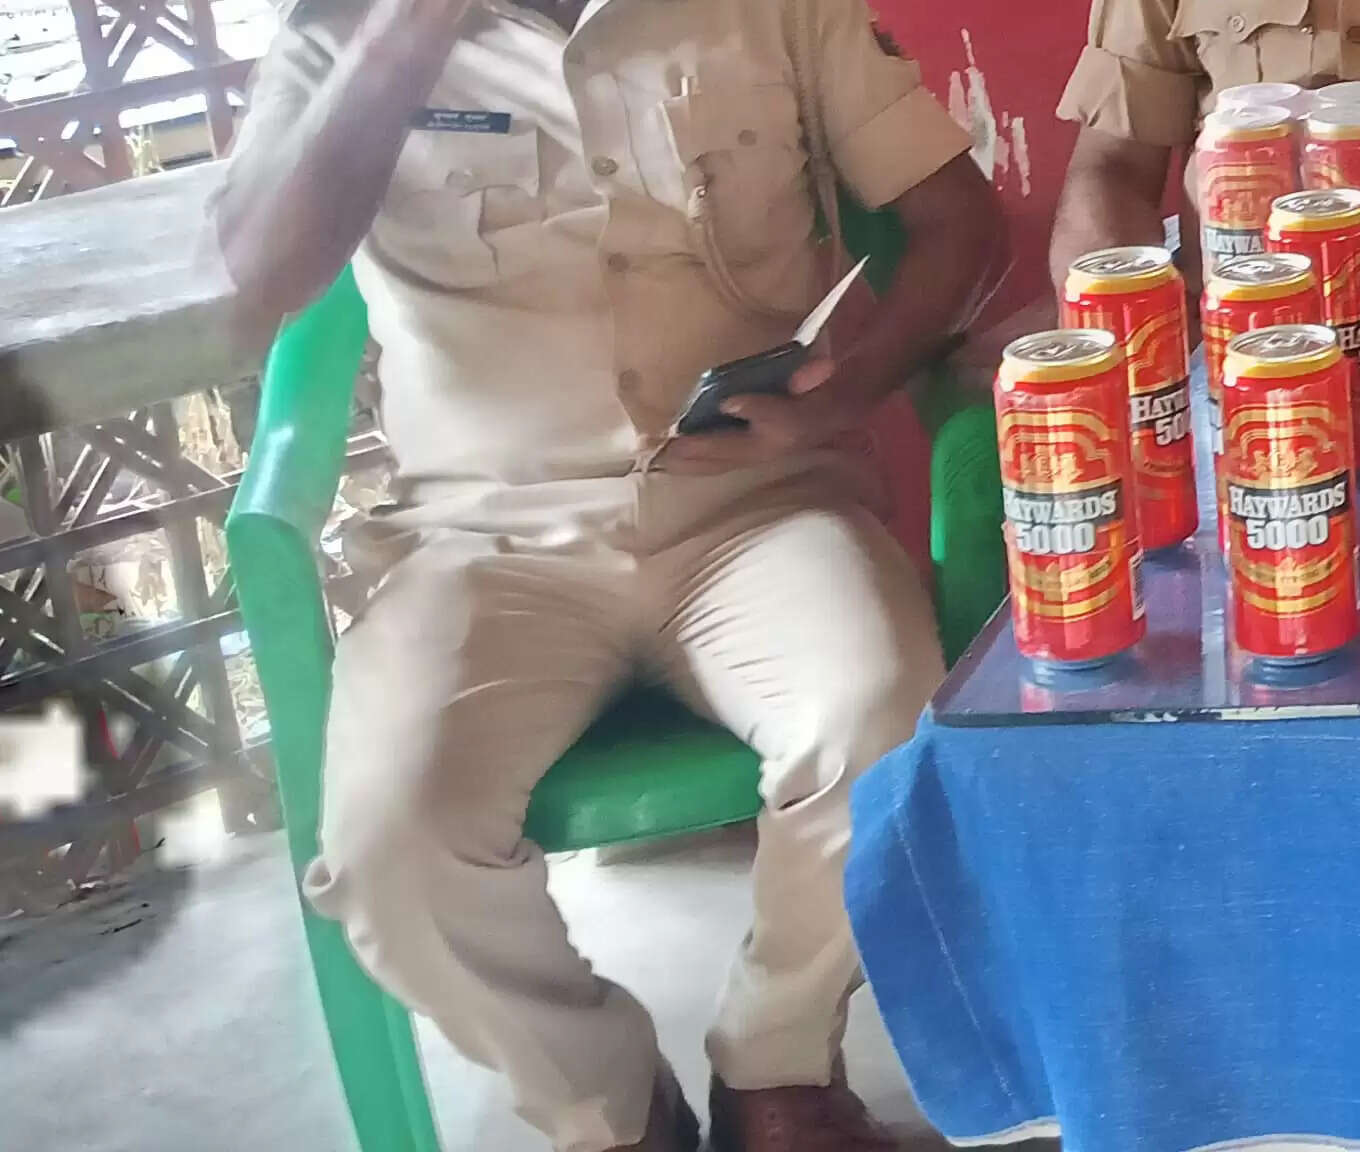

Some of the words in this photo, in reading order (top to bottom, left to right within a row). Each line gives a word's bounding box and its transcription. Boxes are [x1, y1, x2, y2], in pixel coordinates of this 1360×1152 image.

[1229, 481, 1347, 519] HAYWARDS
[1015, 521, 1096, 554] 5000
[1245, 513, 1329, 551] 5000
